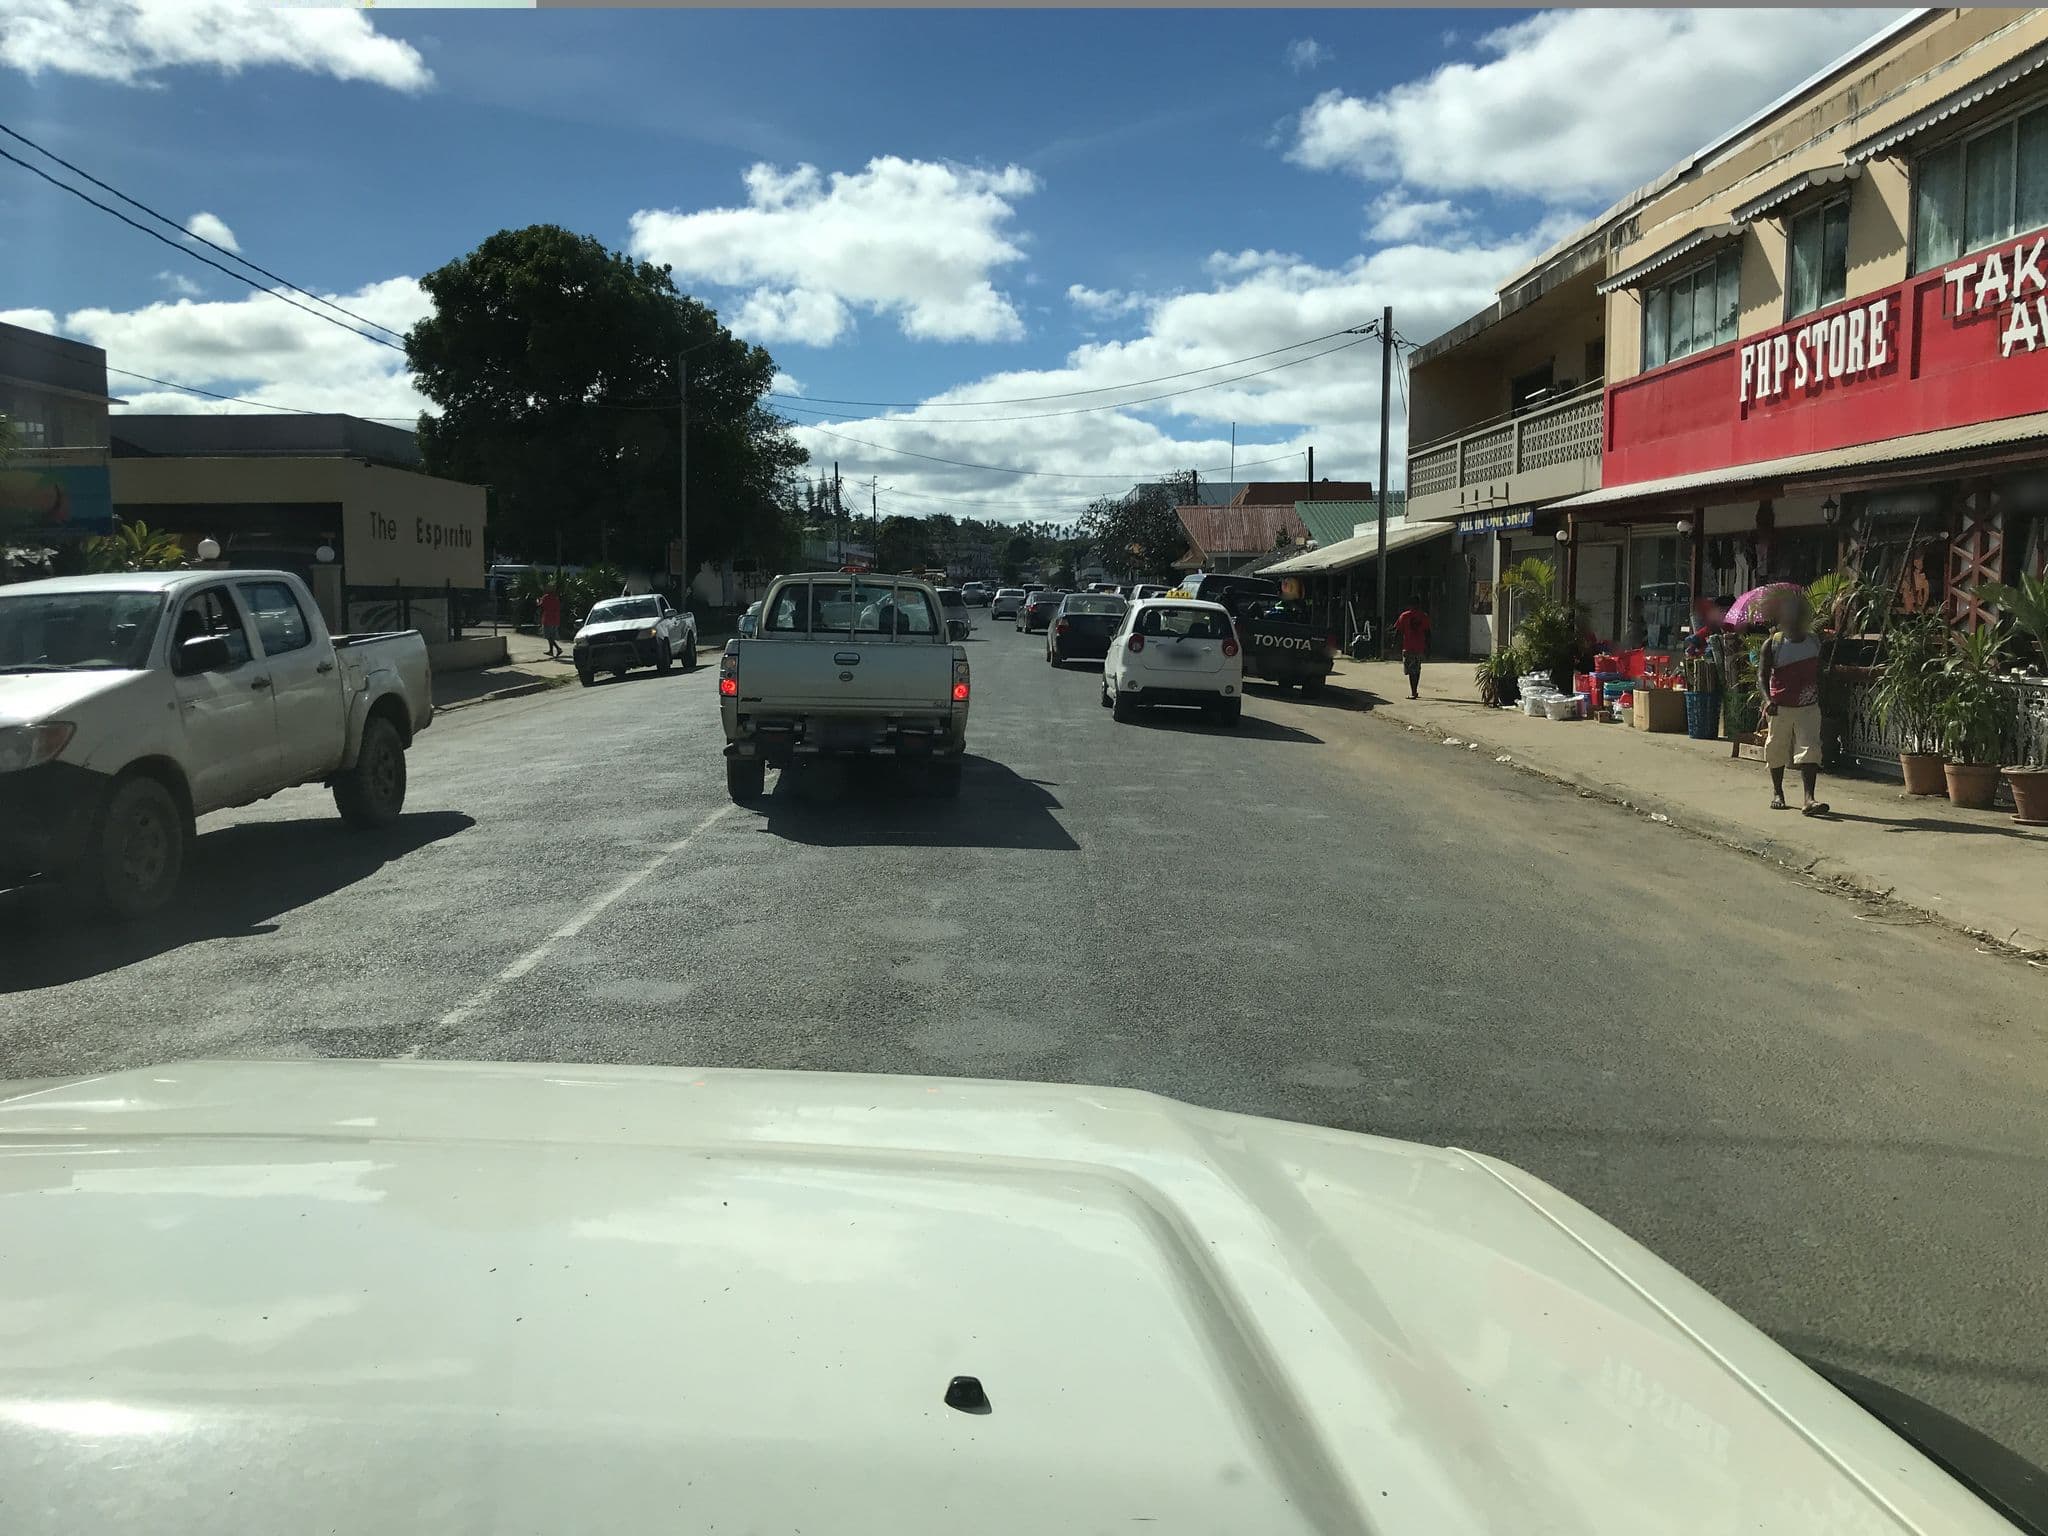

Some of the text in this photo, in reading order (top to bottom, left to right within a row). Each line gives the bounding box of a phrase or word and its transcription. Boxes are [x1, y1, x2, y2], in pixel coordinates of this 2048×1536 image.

[1739, 298, 1888, 402] FHP STORE
[369, 511, 472, 550] The Espiritu
[1460, 507, 1531, 532] ALL IN ONE SHOP
[1253, 633, 1312, 651] TOYOTA
